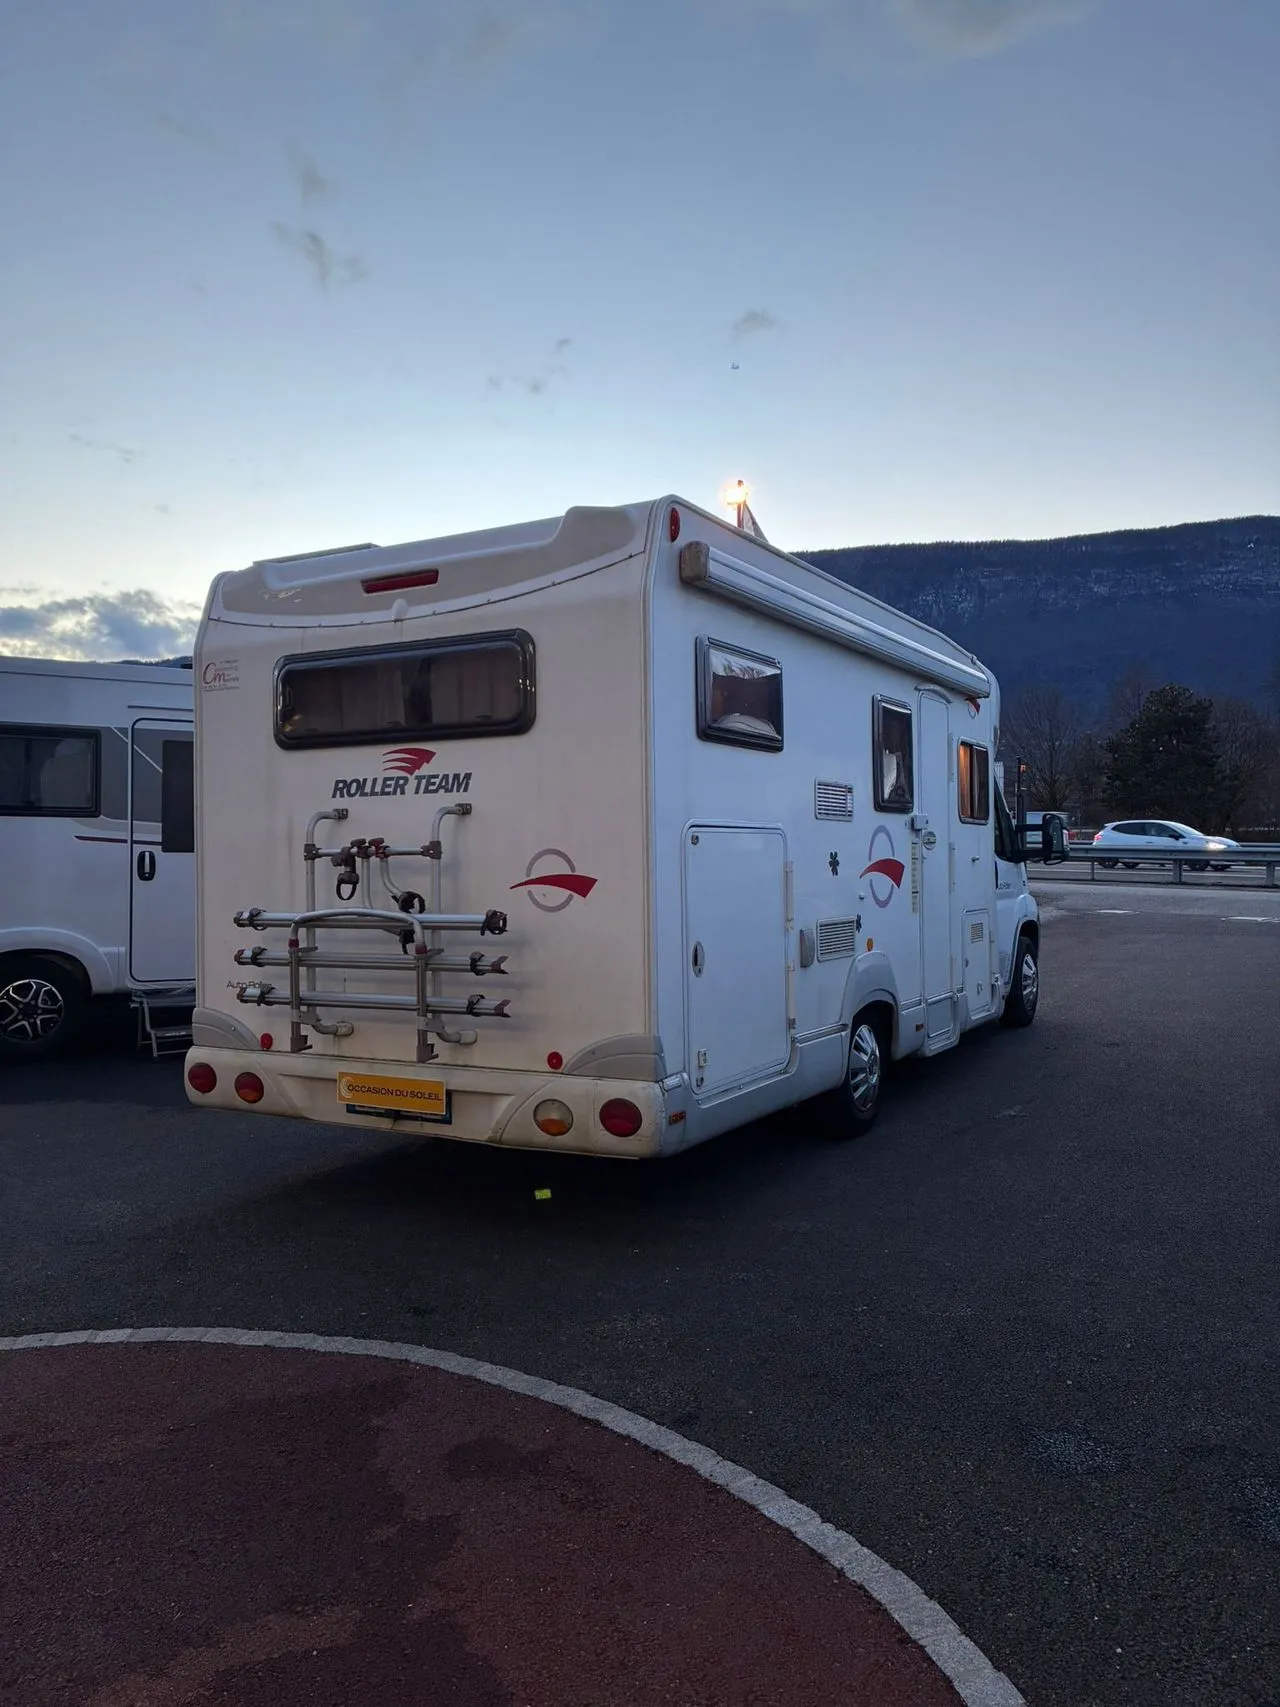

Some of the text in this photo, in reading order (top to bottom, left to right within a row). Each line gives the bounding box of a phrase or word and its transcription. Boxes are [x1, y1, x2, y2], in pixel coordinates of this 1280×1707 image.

[331, 772, 472, 799] ROLLER TEAM
[347, 1084, 444, 1101] OCCASION DU SOLEIL
